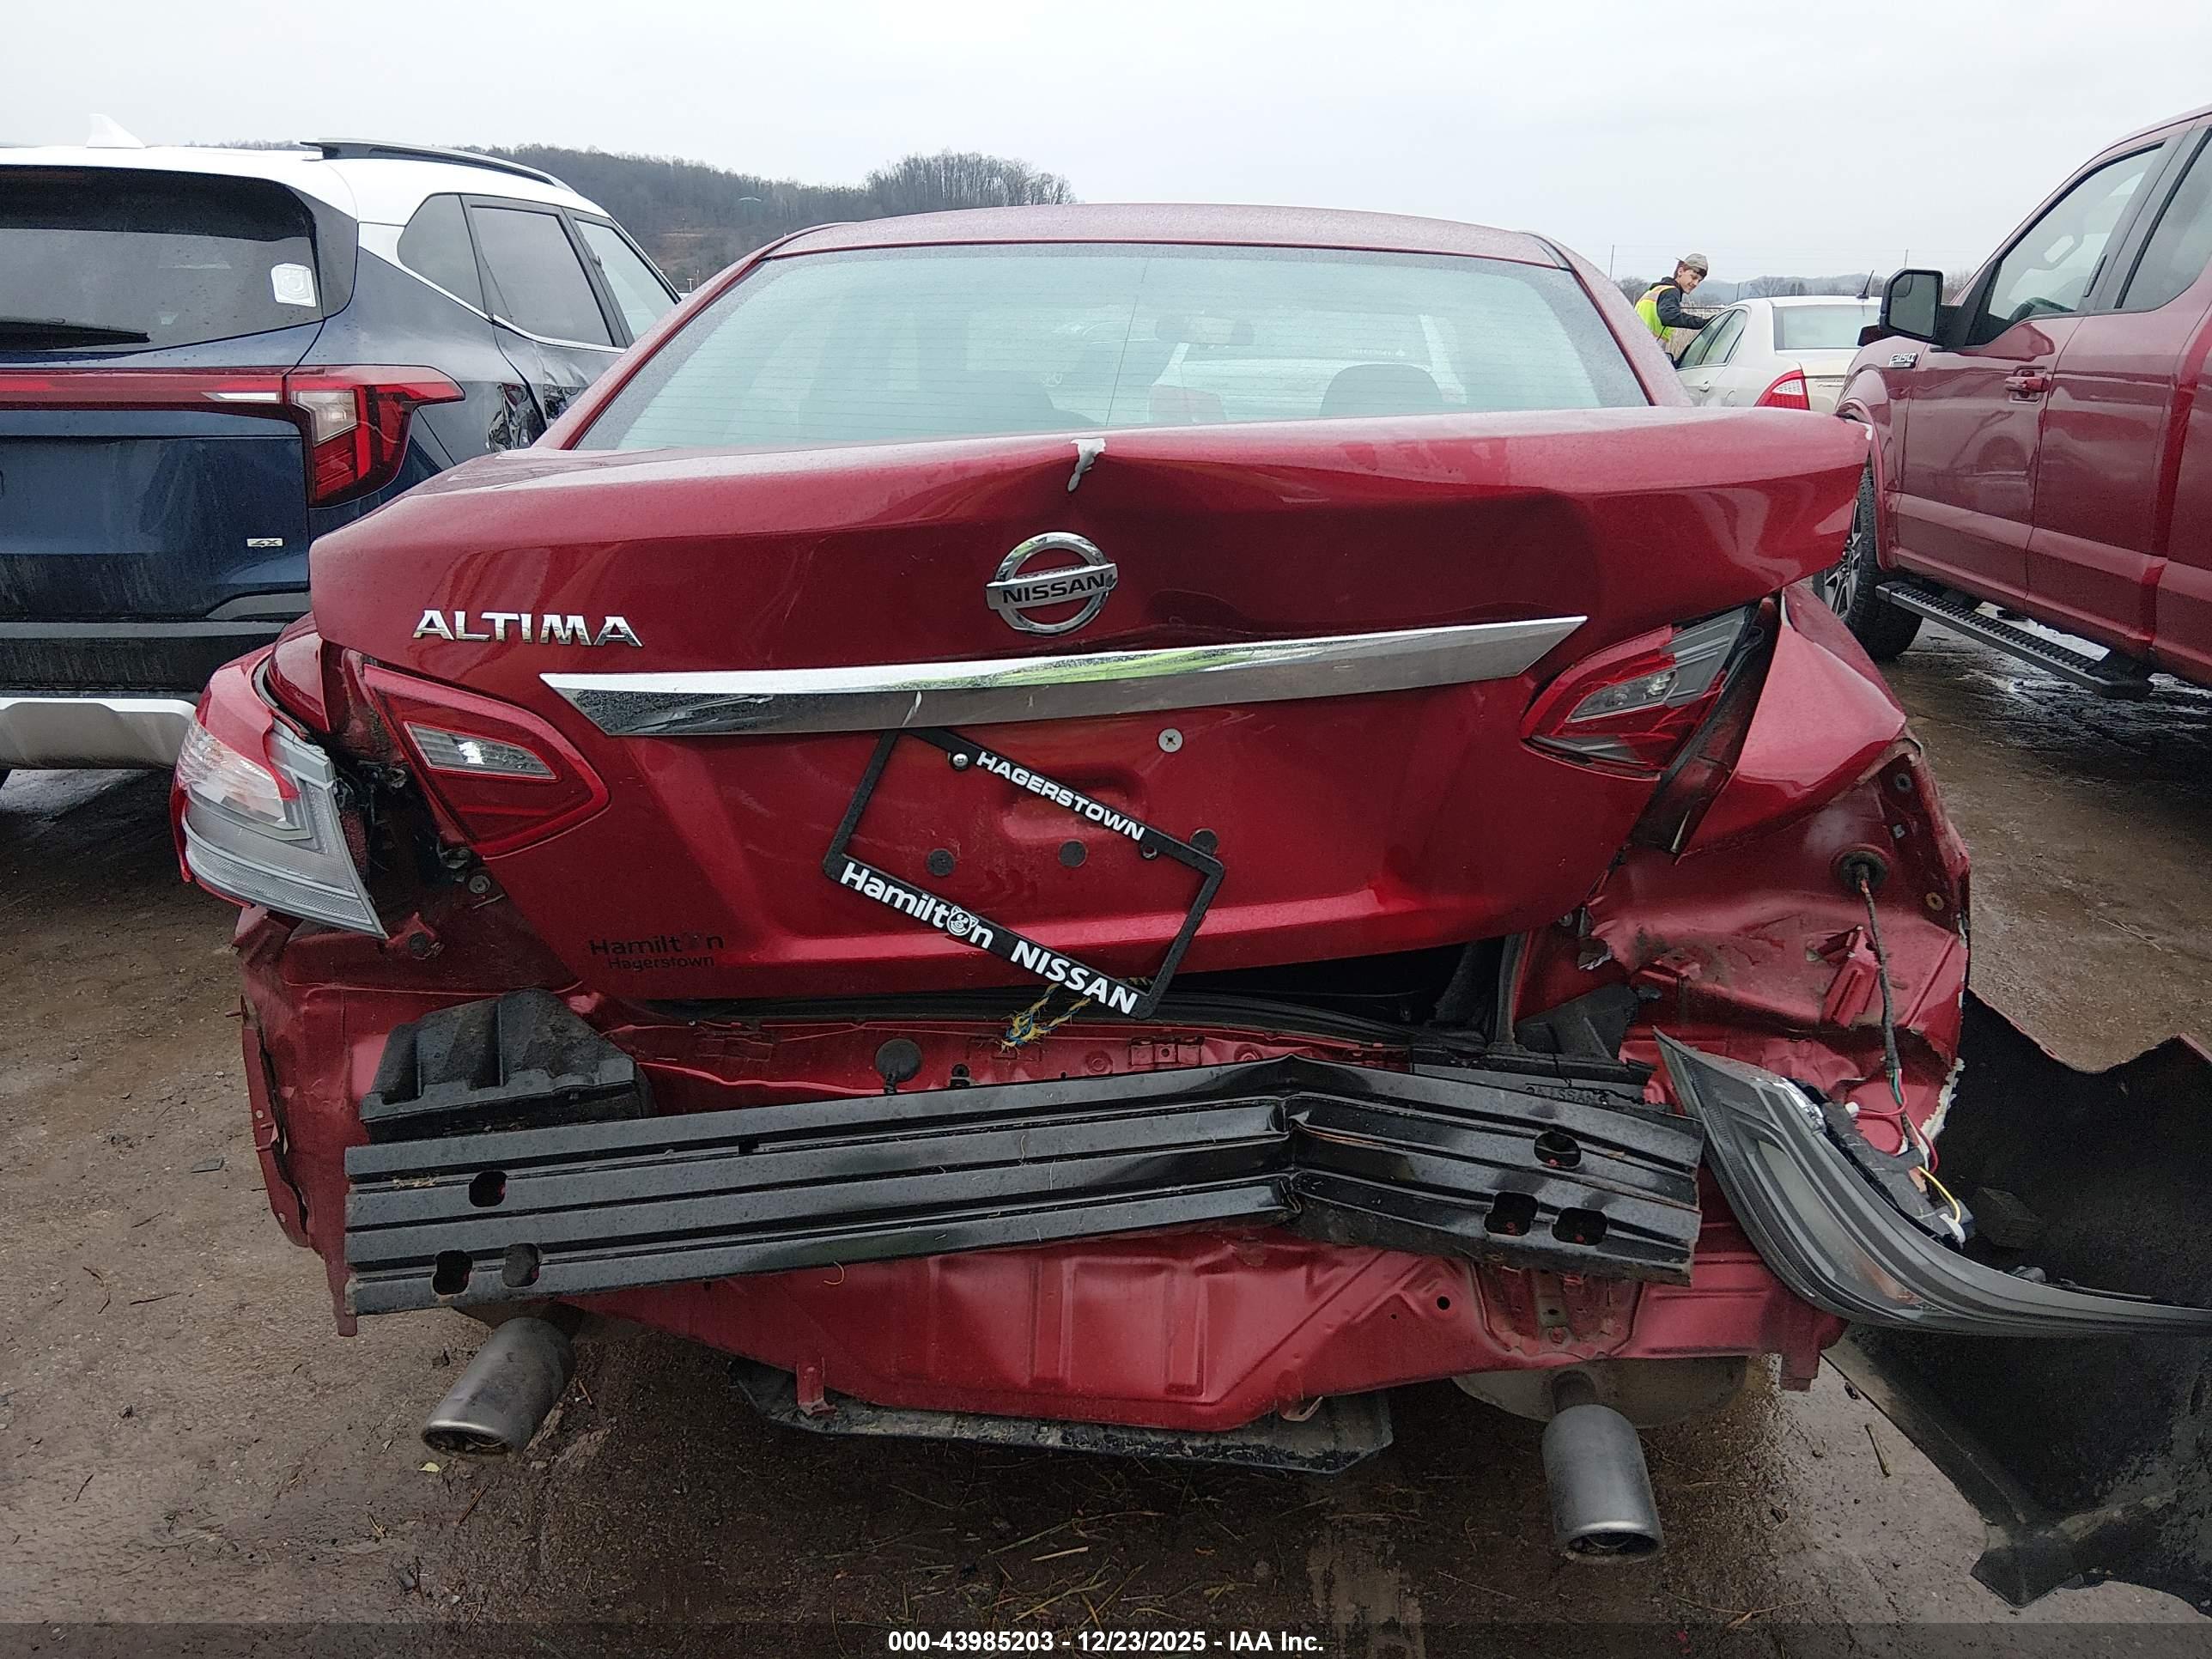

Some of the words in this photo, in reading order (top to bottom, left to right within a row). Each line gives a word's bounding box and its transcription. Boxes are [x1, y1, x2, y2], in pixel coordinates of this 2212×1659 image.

[1002, 573, 1105, 604] NISSAN
[412, 609, 644, 647] ALTIMA
[975, 751, 1146, 842] HAGERSTOWN
[588, 934, 725, 956] Hamiltn
[607, 955, 715, 972] Hagerstown
[1010, 940, 1139, 1015] NISSAN
